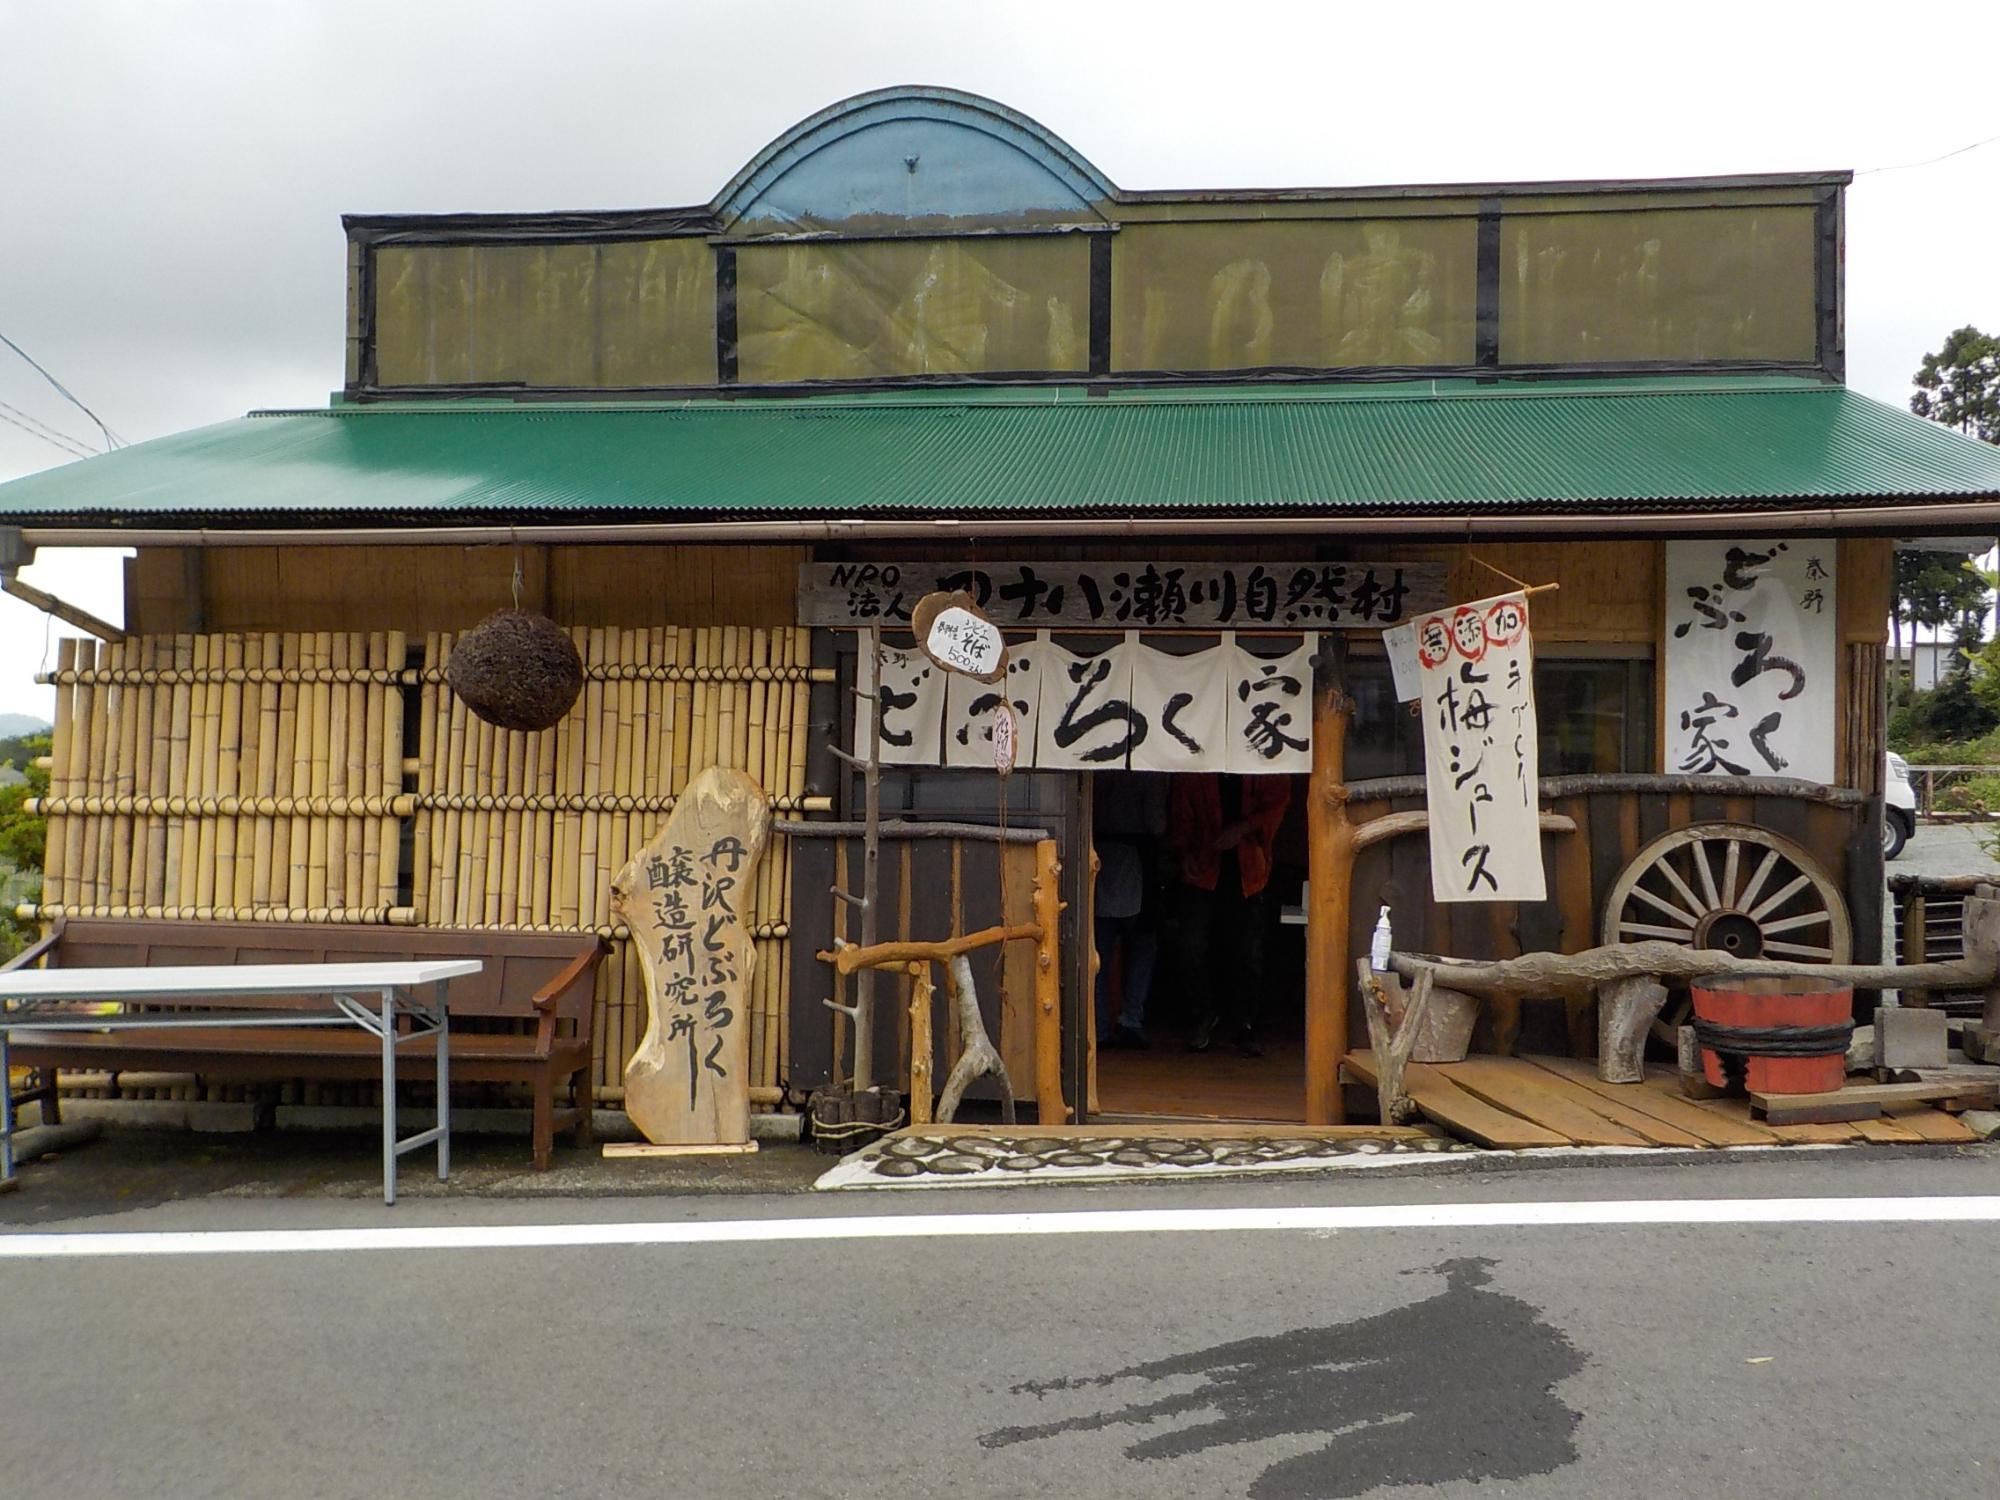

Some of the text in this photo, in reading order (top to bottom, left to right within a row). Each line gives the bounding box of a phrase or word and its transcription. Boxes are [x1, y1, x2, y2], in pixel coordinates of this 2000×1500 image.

[829, 563, 901, 588] NPO
[1799, 556, 1829, 614] 秦野
[846, 589, 914, 622] 法人
[960, 632, 991, 659] そば
[1422, 606, 1518, 658] 無添加
[646, 846, 699, 1112] 醸造研究所
[699, 836, 748, 1079] 丹沢どぶろく
